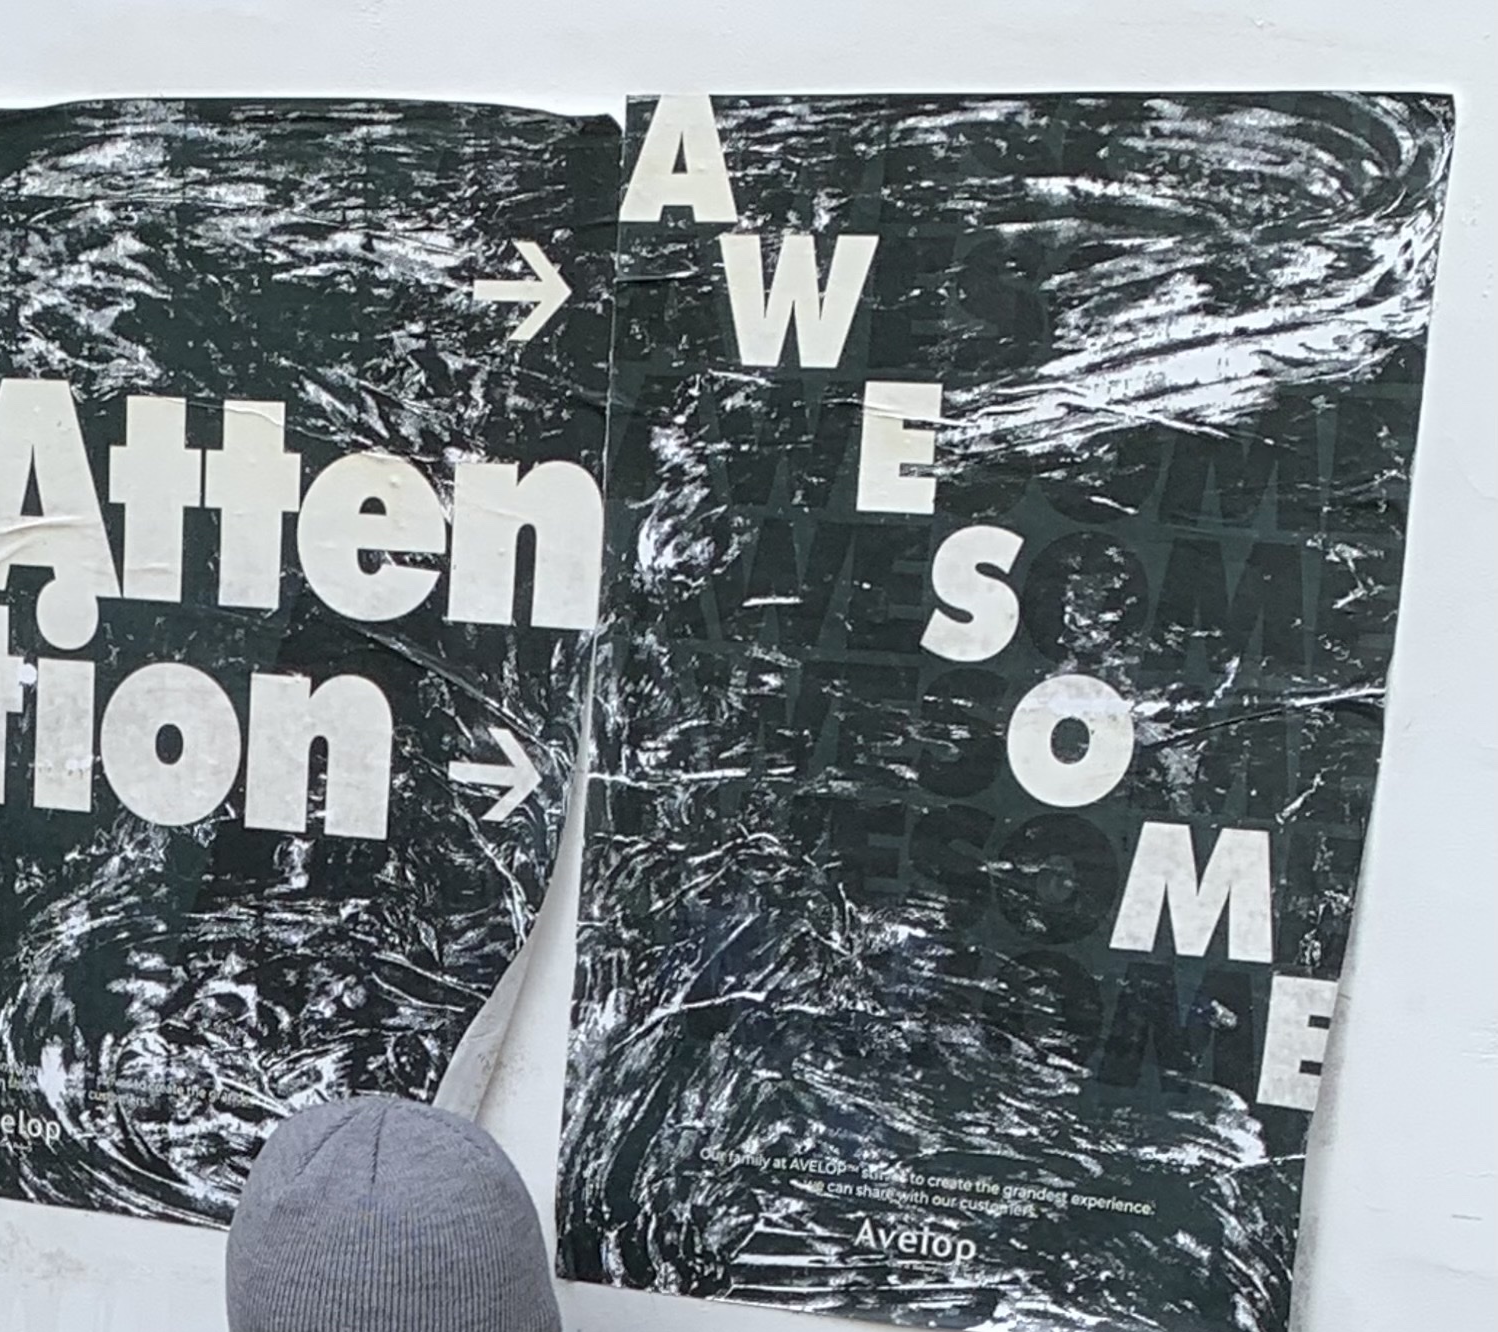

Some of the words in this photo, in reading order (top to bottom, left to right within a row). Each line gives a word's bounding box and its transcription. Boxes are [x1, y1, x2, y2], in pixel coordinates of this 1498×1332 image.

[728, 1150, 770, 1171] family
[772, 1156, 787, 1170] at
[910, 1172, 925, 1185] to
[927, 1175, 972, 1192] create
[975, 1178, 1000, 1195] the
[1002, 1184, 1068, 1203] grandest
[1071, 1193, 1156, 1216] experience.
[827, 1181, 852, 1195] can
[895, 1187, 929, 1206] with
[931, 1193, 957, 1207] our
[854, 1217, 977, 1273] Avelop
